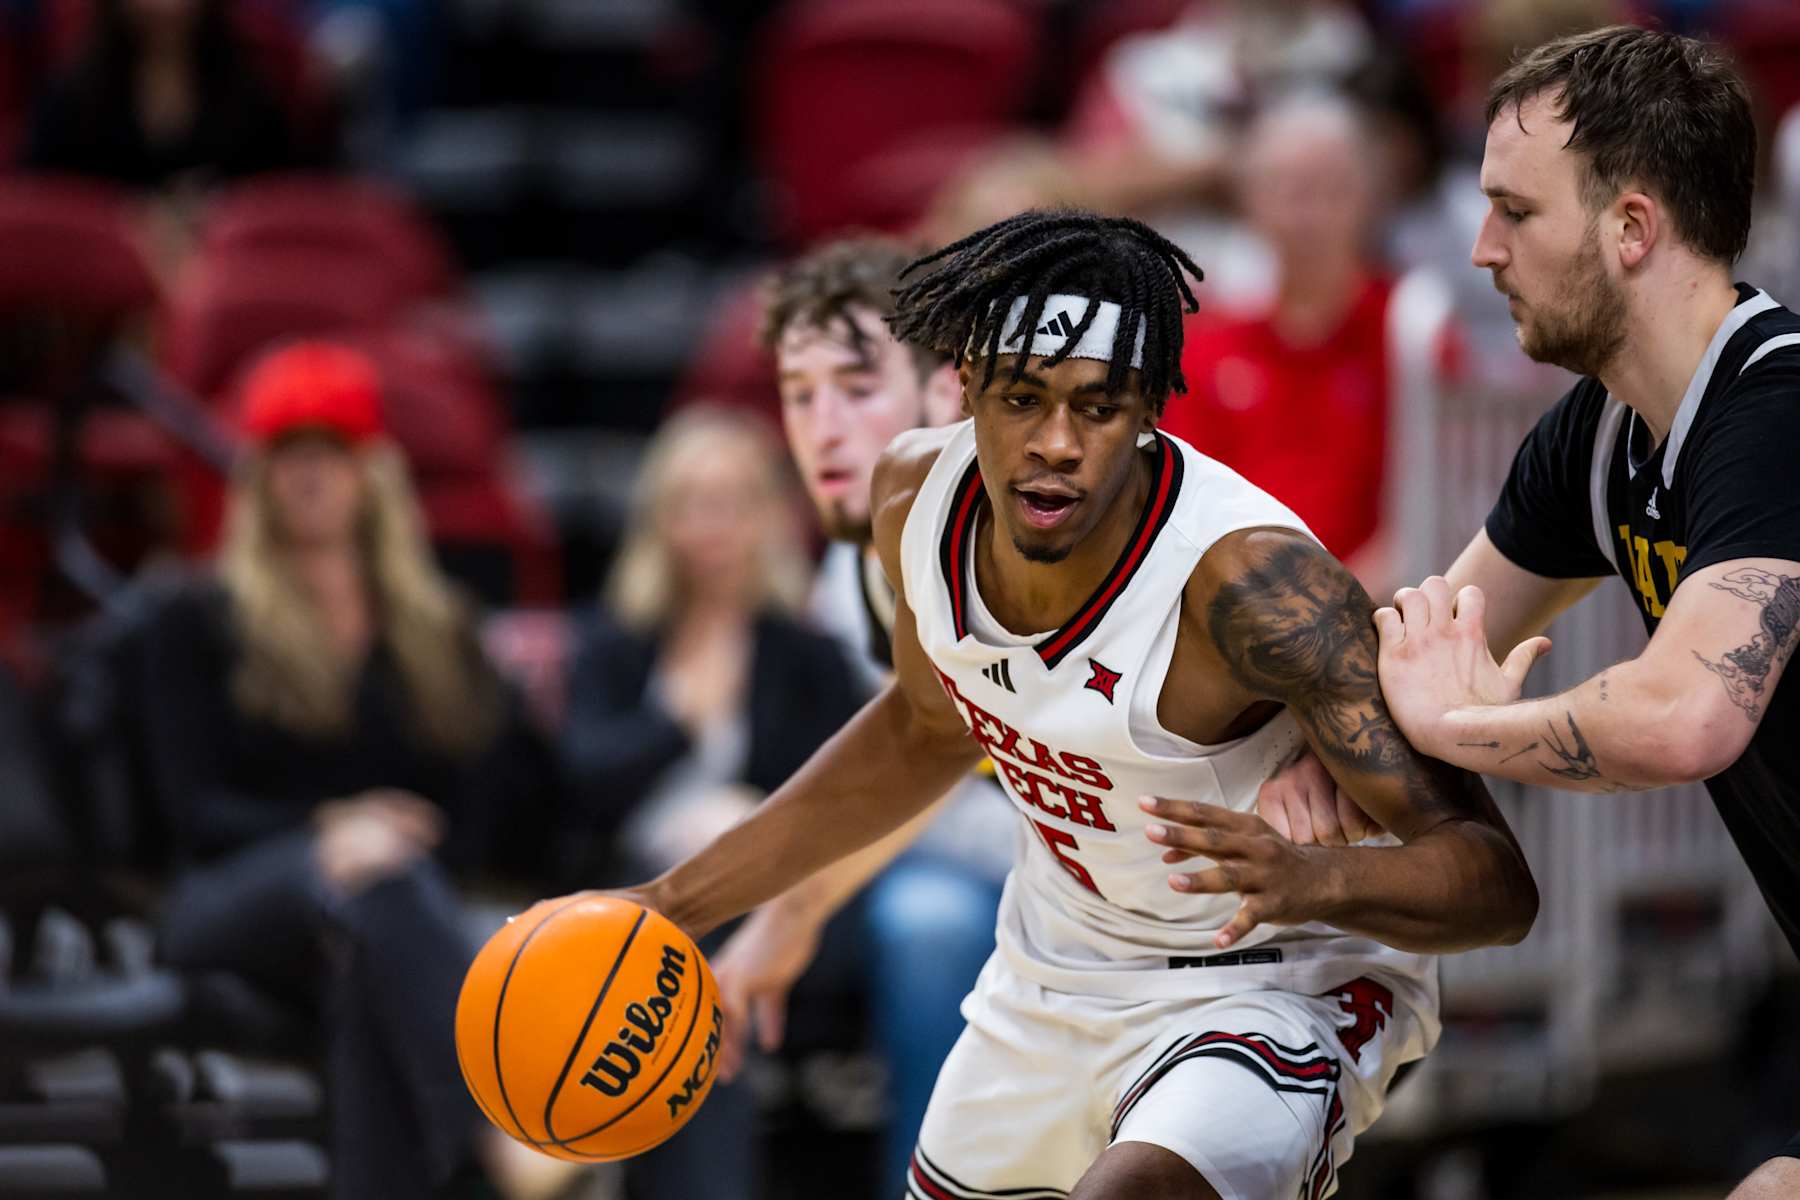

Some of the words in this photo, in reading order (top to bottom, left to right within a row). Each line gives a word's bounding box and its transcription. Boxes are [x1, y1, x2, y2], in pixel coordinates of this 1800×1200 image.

[986, 743, 1117, 832] ECH
[579, 944, 686, 1097] Wilson
[666, 1002, 723, 1119] NCAA
